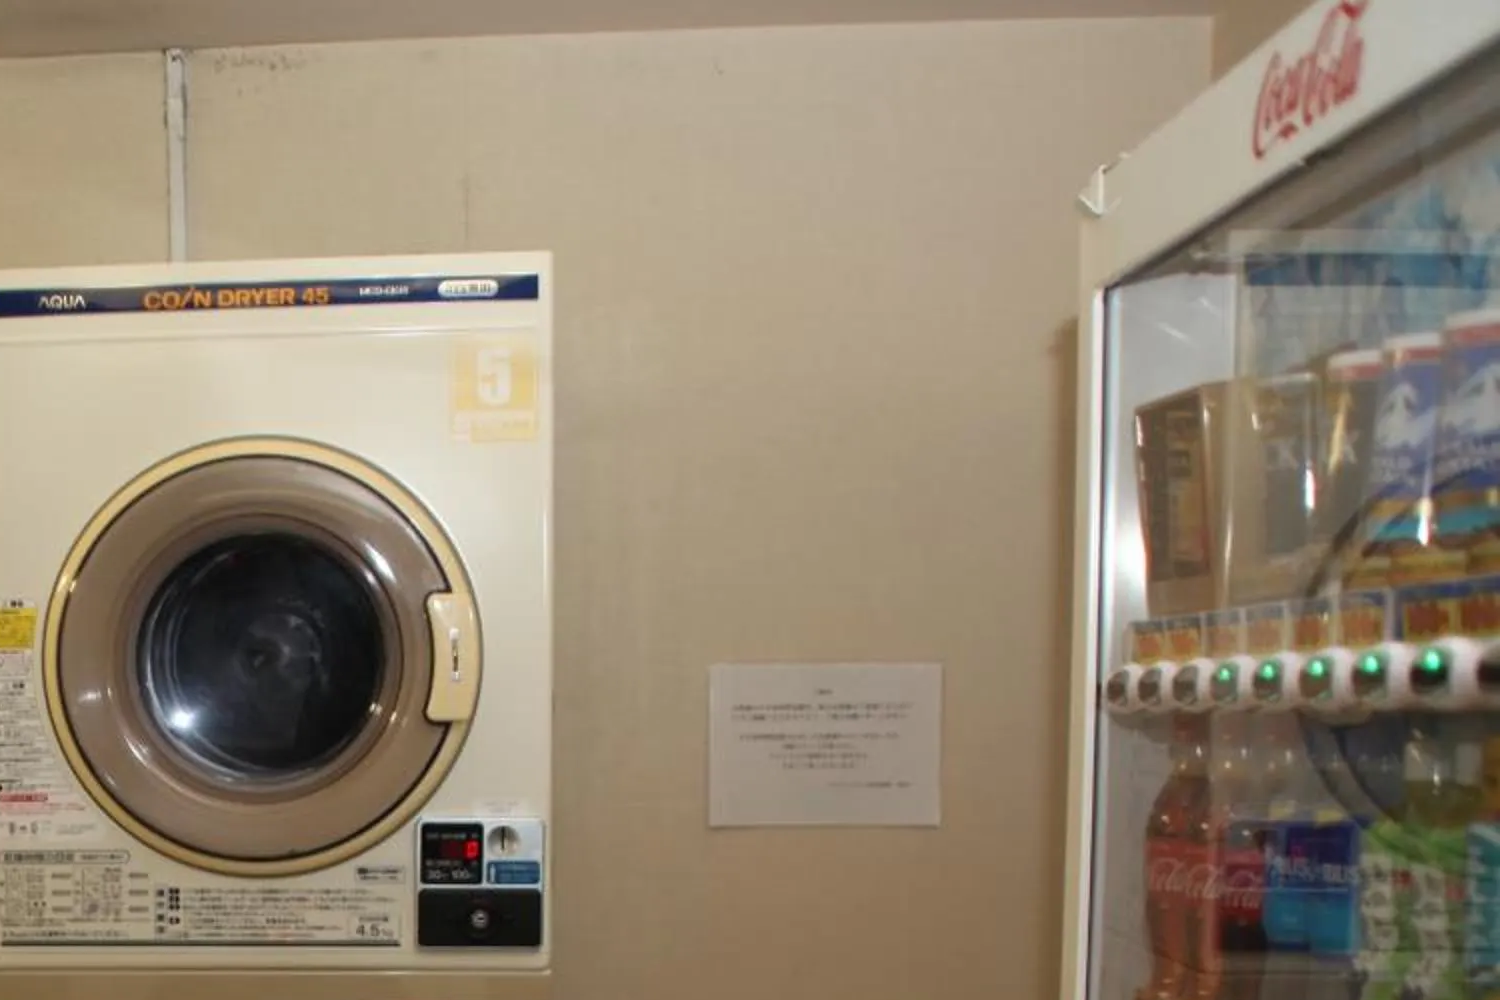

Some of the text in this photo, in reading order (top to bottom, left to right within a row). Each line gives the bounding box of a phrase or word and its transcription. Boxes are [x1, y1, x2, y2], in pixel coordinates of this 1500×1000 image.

[37, 294, 87, 310] AQUA
[217, 287, 296, 308] DRYER
[302, 286, 329, 304] 45
[477, 348, 512, 406] 5
